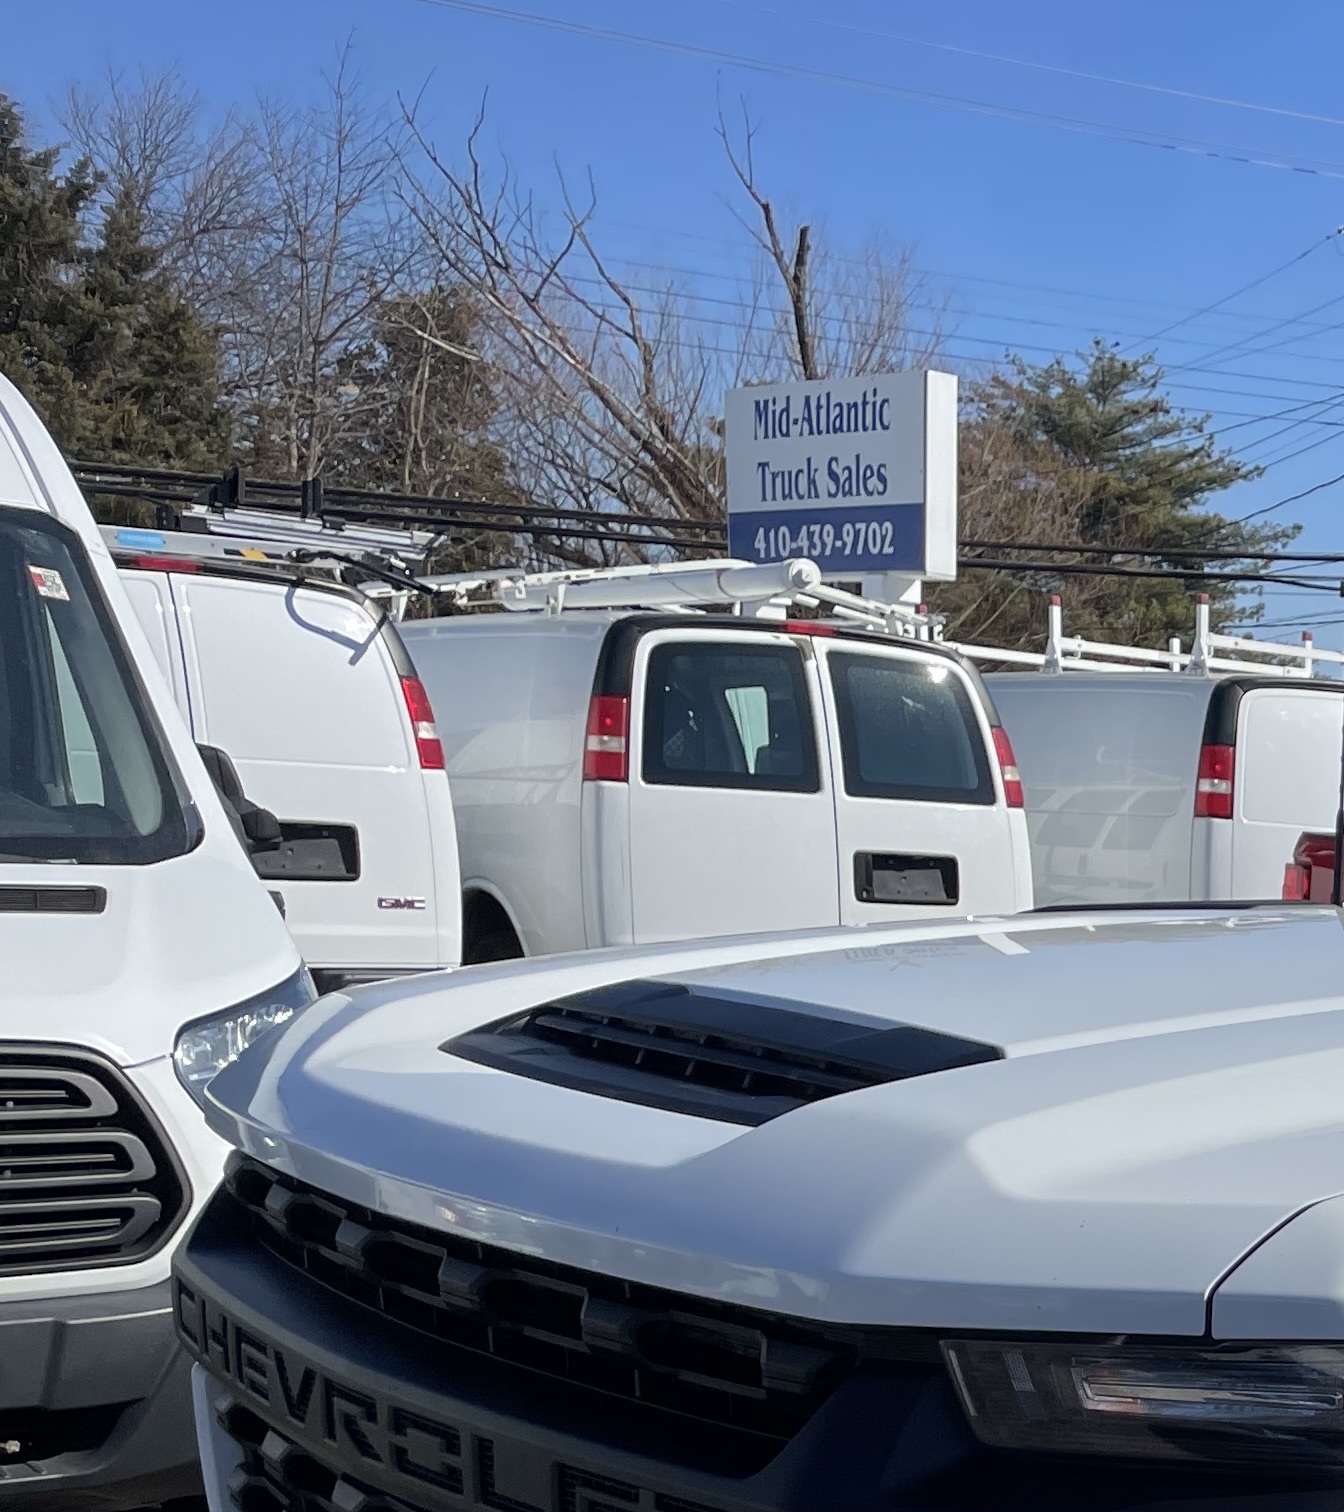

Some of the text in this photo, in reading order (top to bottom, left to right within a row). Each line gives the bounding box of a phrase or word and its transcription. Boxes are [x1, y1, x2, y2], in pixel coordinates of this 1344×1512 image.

[754, 387, 891, 441] Mid-Atlantic
[756, 454, 888, 502] Truck Sales
[754, 521, 895, 559] 410-439-9702
[377, 896, 426, 910] GMC
